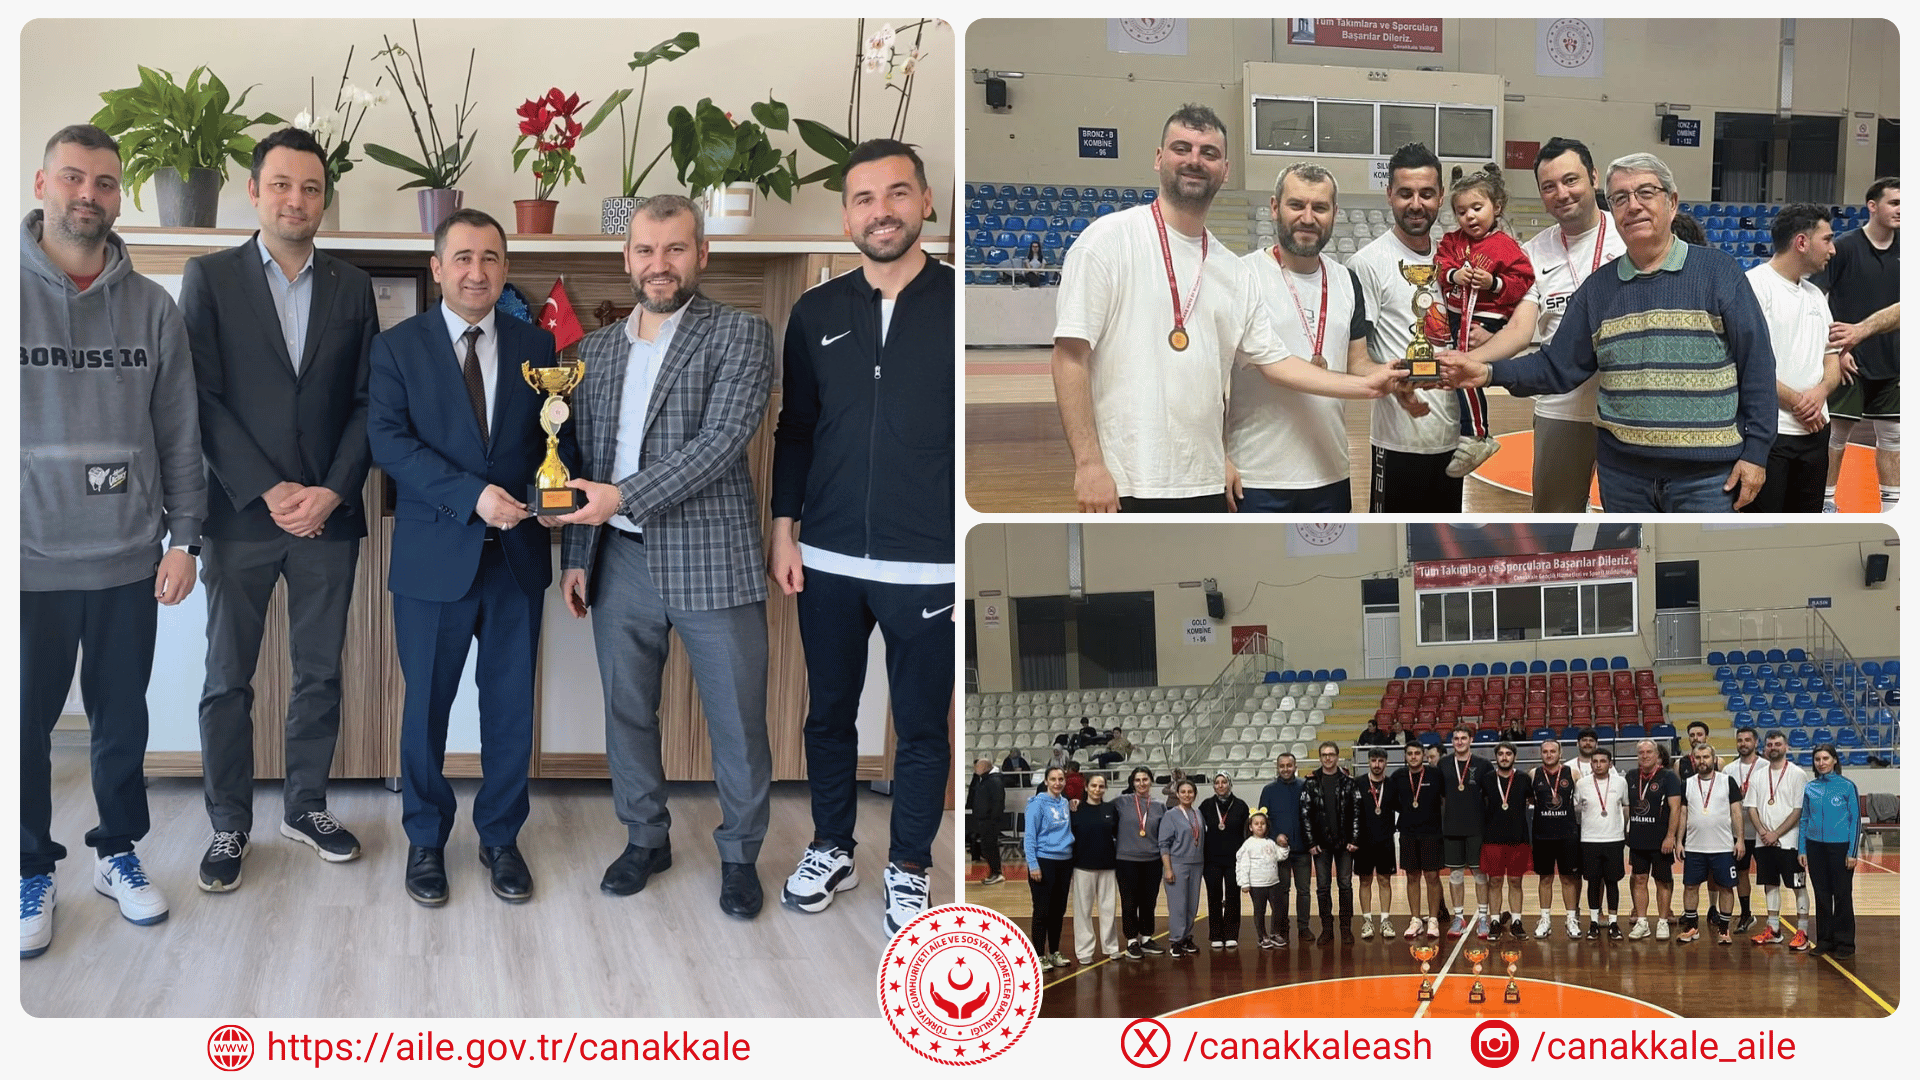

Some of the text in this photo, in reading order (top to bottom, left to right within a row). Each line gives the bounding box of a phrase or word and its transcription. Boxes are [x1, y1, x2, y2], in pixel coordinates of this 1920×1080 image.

[1336, 18, 1378, 29] Takımlara
[1391, 21, 1438, 32] Sporculara
[1341, 30, 1413, 43] Başarılar Dileriz.
[1082, 130, 1104, 138] BRONZ
[1676, 129, 1696, 137] OMBİNE
[20, 346, 148, 369] BORUSSIA
[1419, 554, 1633, 577] Tüm Takımlara ve Sporculara Başarılar Dileriz.
[1729, 865, 1737, 879] 6
